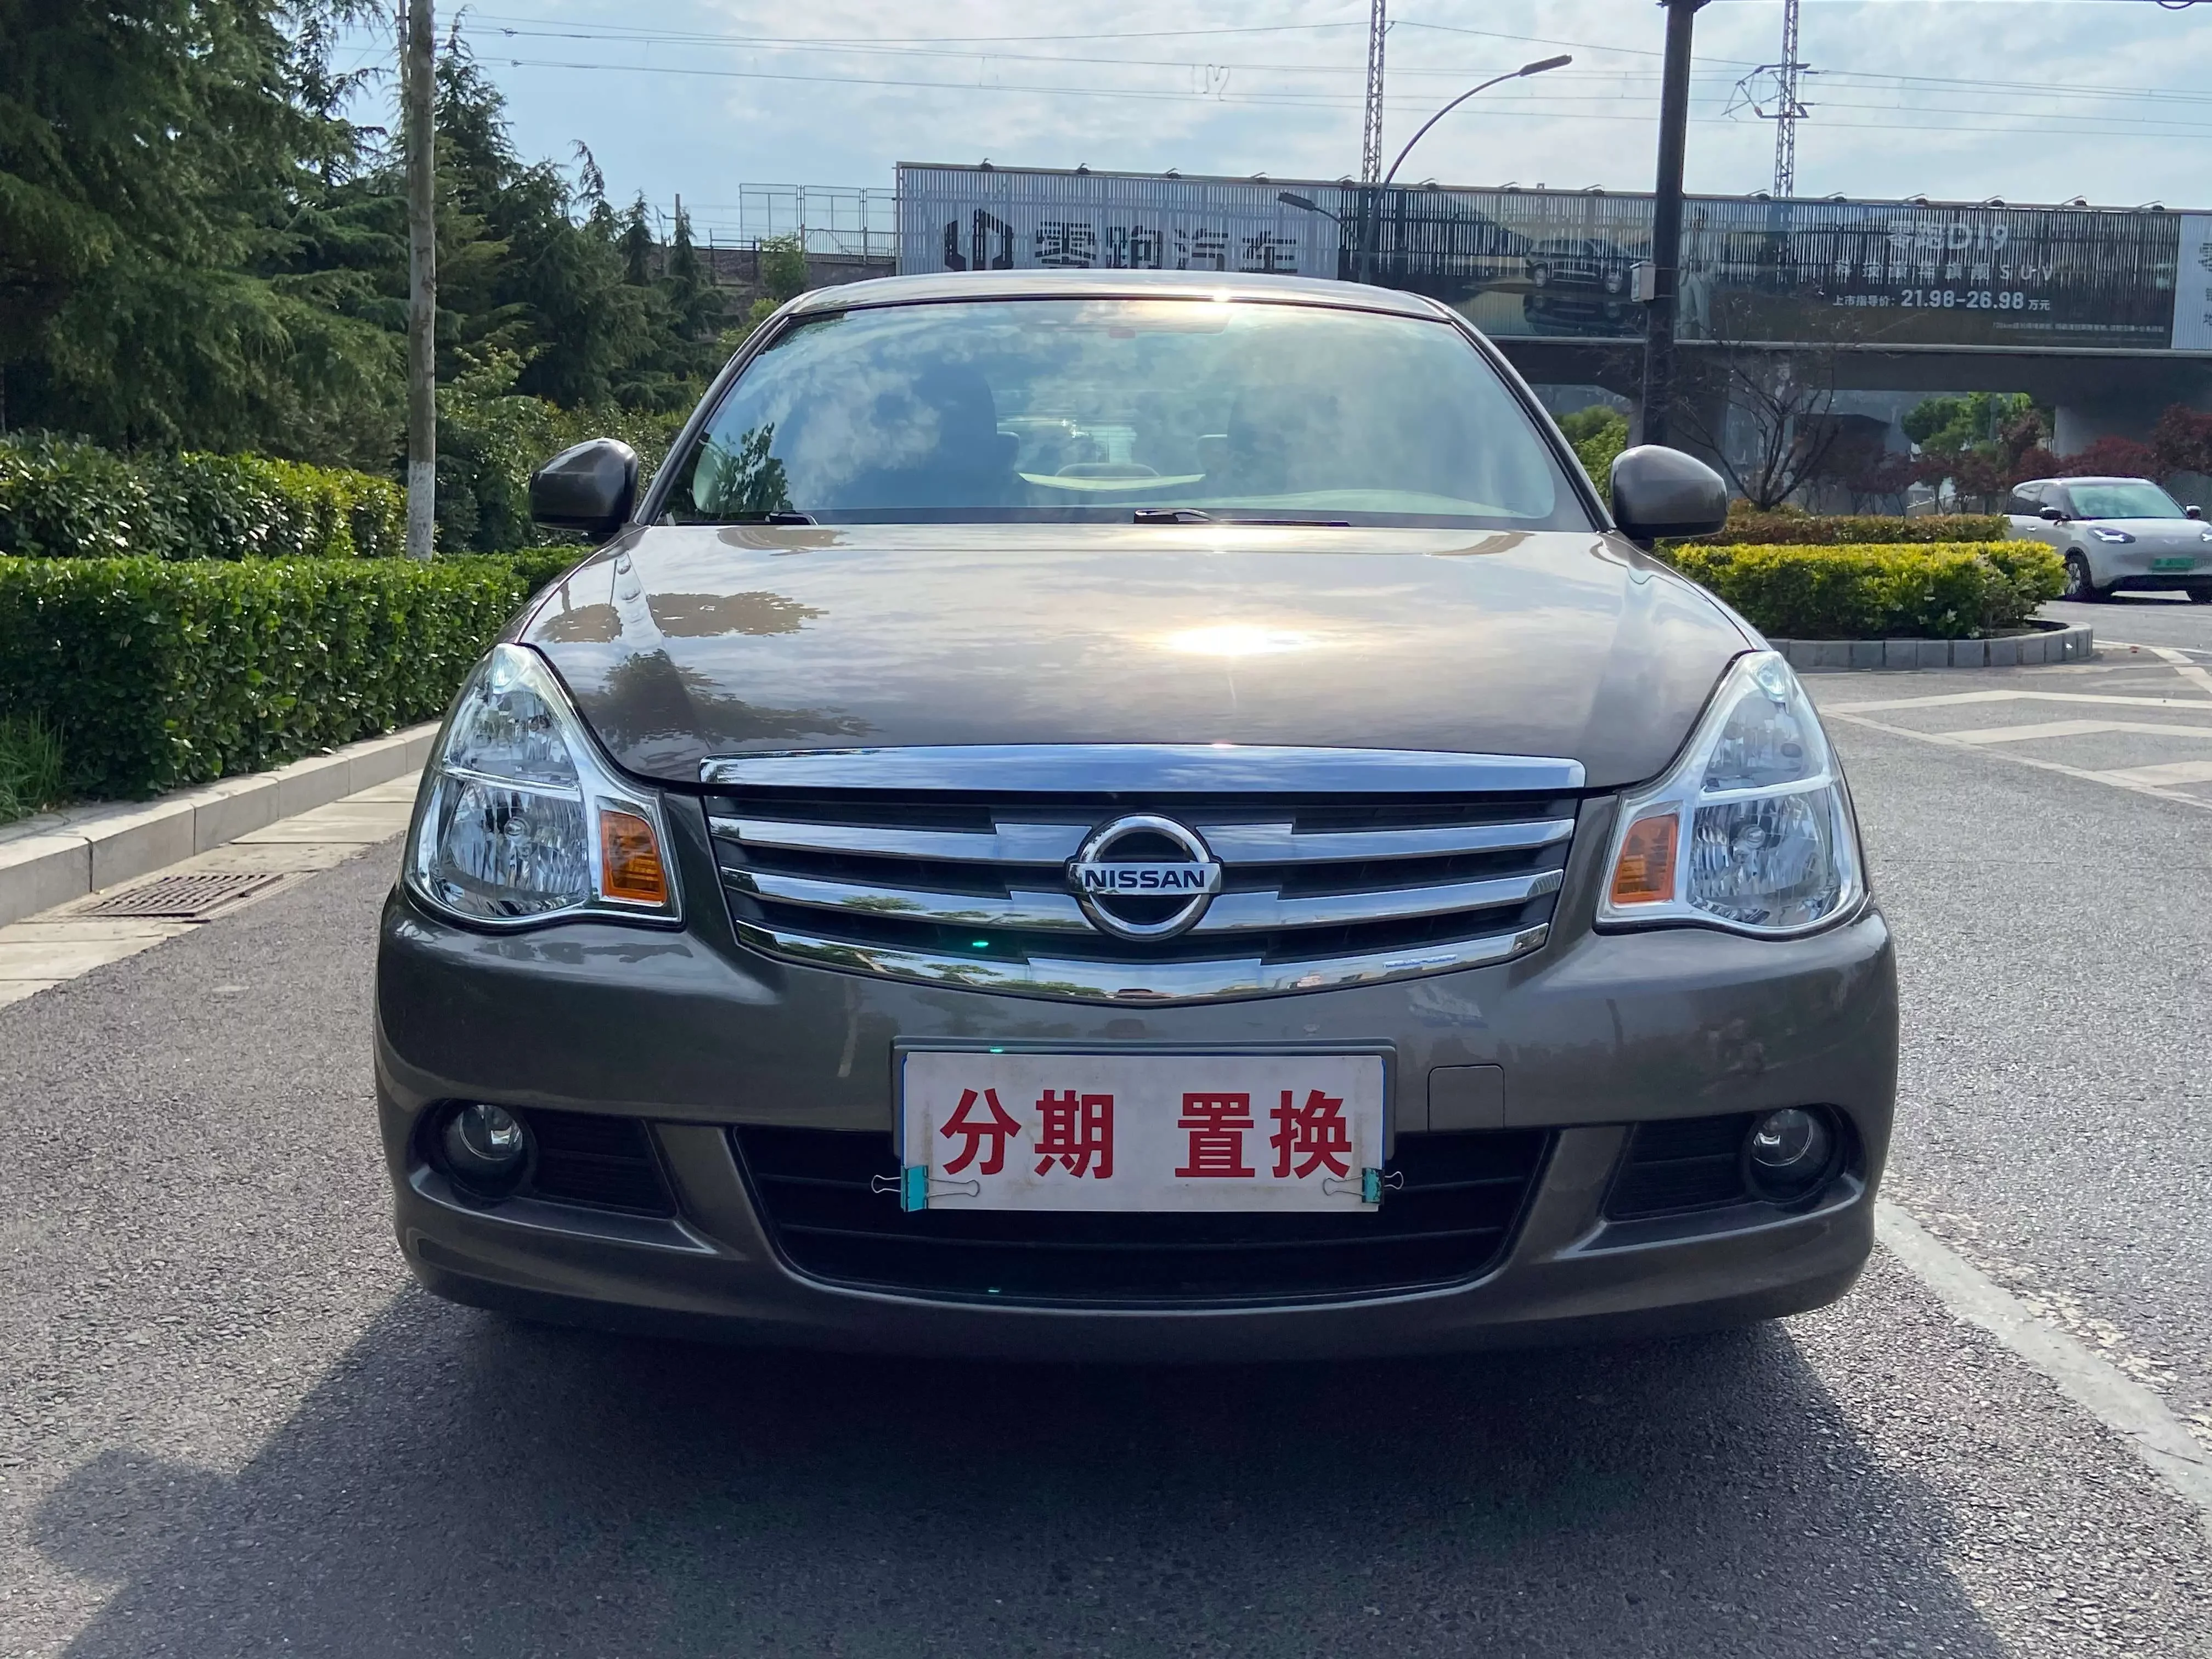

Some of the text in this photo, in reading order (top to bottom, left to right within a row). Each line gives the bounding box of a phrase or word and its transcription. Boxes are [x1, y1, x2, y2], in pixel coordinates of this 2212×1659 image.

[1035, 221, 1297, 273] 零跑汽车
[1085, 870, 1205, 888] NISSAN
[940, 1088, 1353, 1179] 分期 置换
